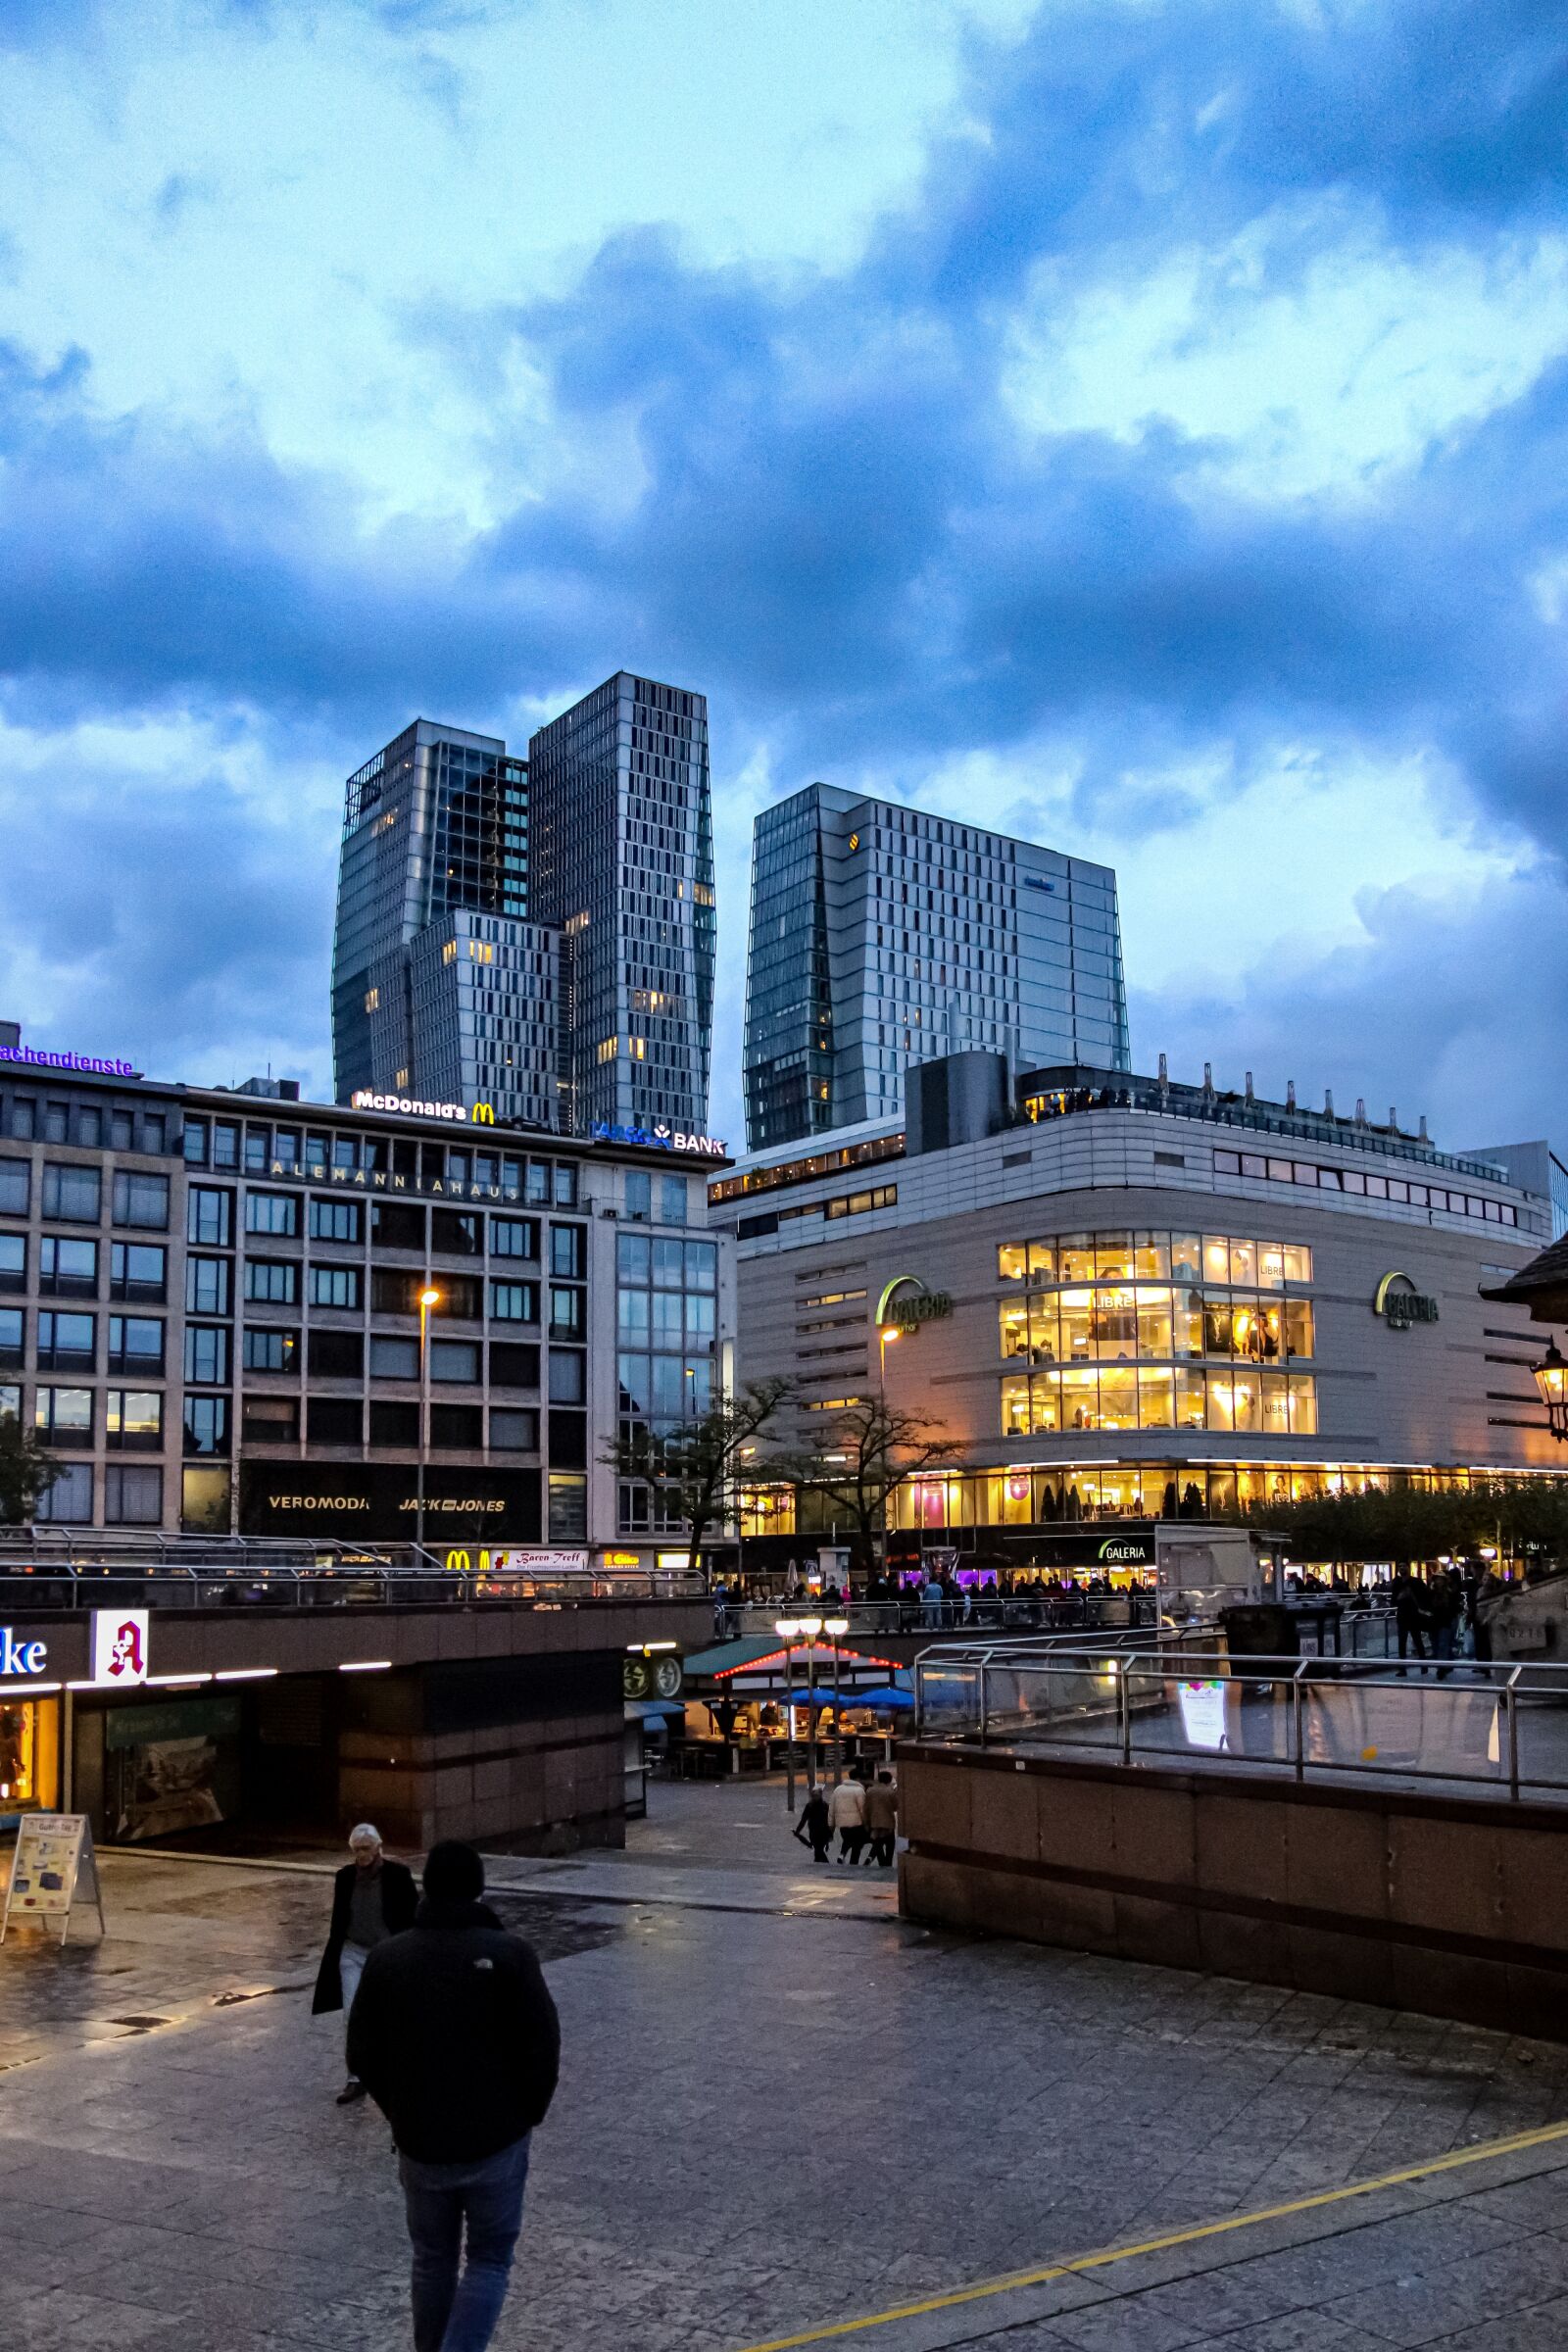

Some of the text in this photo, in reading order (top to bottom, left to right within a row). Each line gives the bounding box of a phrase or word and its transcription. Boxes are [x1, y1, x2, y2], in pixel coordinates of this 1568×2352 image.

[356, 1091, 466, 1120] McDonald's
[673, 1132, 724, 1154] BANK
[1260, 1265, 1284, 1276] LIBRE
[1093, 1296, 1134, 1308] LIBRE
[457, 1500, 506, 1512] JONES
[1106, 1546, 1146, 1559] GALERIA
